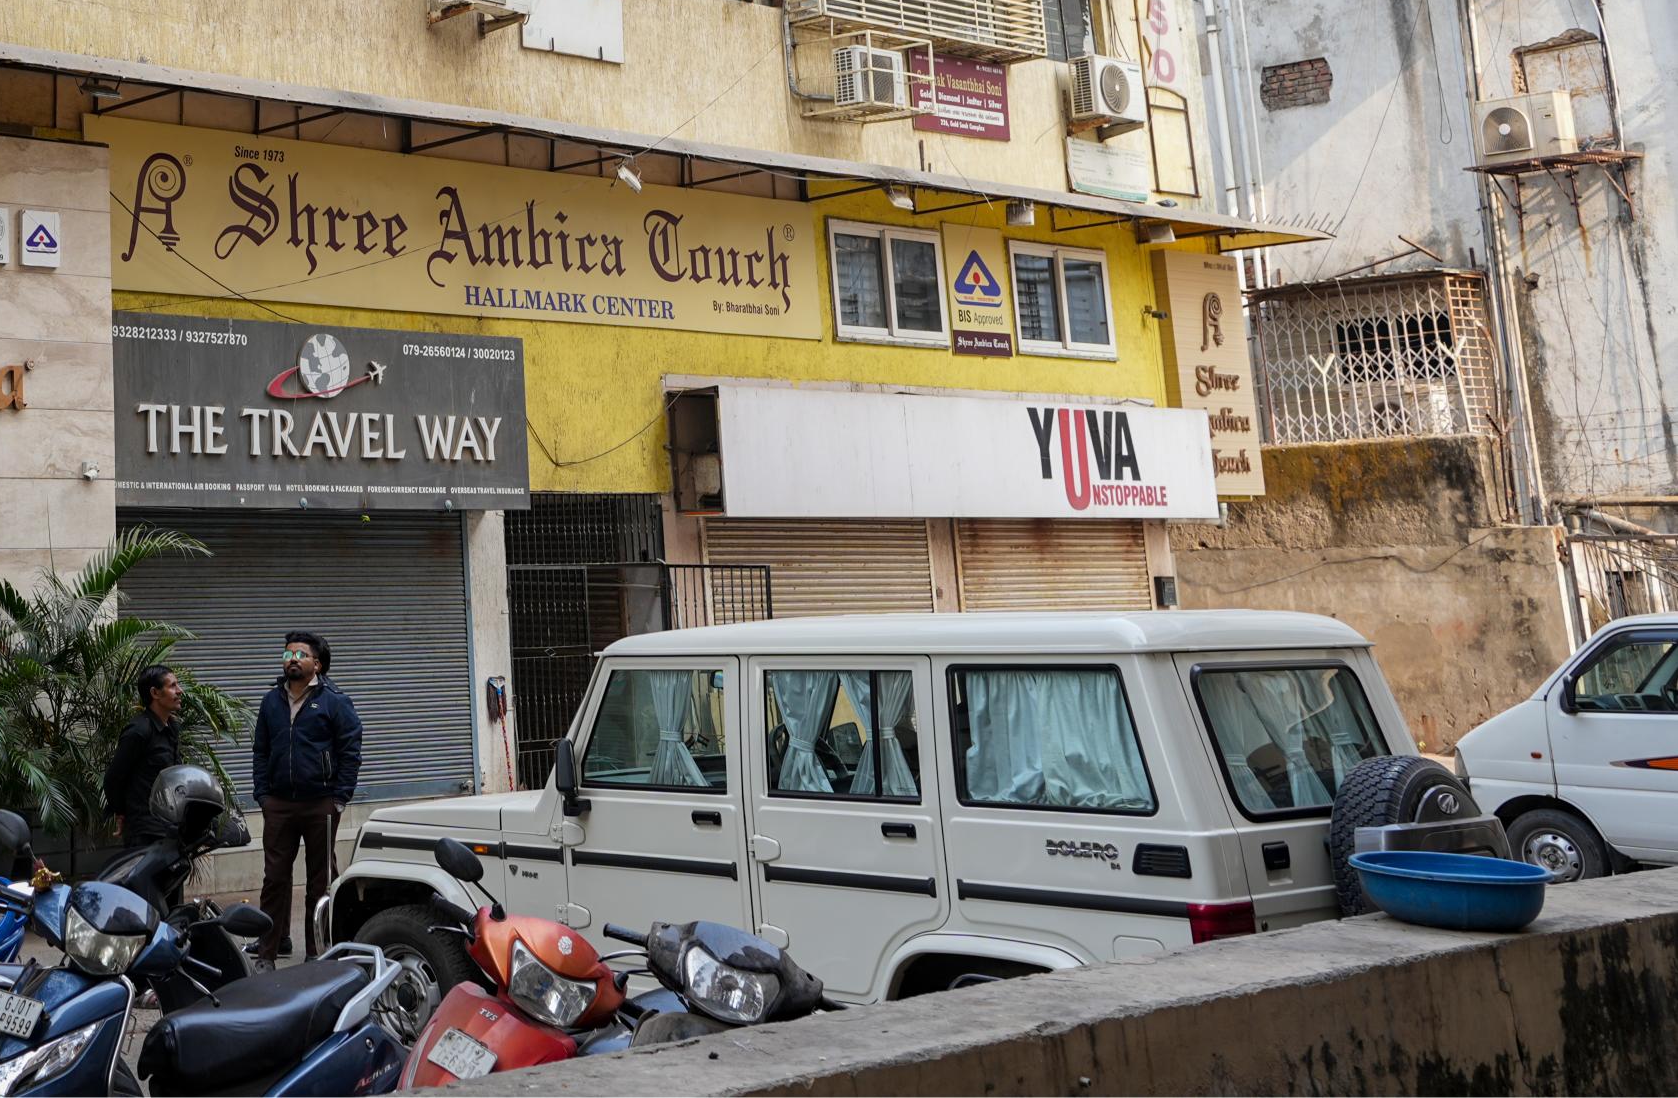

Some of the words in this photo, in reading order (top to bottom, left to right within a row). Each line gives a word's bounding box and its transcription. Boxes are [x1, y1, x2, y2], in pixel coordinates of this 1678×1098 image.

[946, 74, 985, 93] Vasantbhai
[987, 81, 1002, 96] Soni
[919, 89, 932, 99] Gold
[938, 92, 960, 103] Diamond
[234, 145, 260, 160] Since
[263, 150, 285, 163] 1973
[214, 162, 408, 275] Shree
[427, 186, 626, 287] Ambica
[643, 209, 791, 314] Touch
[464, 285, 587, 313] HALLMARK
[592, 294, 676, 320] CENTER
[713, 300, 724, 314] By:
[726, 301, 763, 315] Bharatbhai
[764, 304, 780, 316] Soni
[958, 309, 972, 323] BIS
[974, 312, 1003, 326] Approved
[112, 325, 177, 342] 9328212333
[186, 331, 248, 346] 9327527870
[403, 344, 465, 358] 079-26560124
[473, 348, 516, 361] 30020123
[1195, 365, 1240, 397] Shree
[137, 403, 228, 455] THE
[240, 407, 406, 460] TRAVEL
[416, 414, 502, 461] WAY
[1207, 406, 1251, 439] mbica
[1026, 407, 1141, 511] YUVA
[115, 481, 139, 489] MESTIC
[146, 481, 193, 490] INTERNATIONAL
[204, 483, 231, 491] BOOKING
[286, 484, 304, 492] HOTEL
[305, 484, 329, 492] BOOKING
[335, 485, 363, 493] PACKAGES
[368, 485, 390, 493] FOREIGN
[390, 485, 418, 494] CURRENCY
[419, 486, 446, 494] EXCHANGE
[450, 486, 477, 494] OVERSEAS
[1046, 838, 1119, 861] BOLERO
[5, 996, 32, 1017] GJ01
[479, 1007, 498, 1021] TVS
